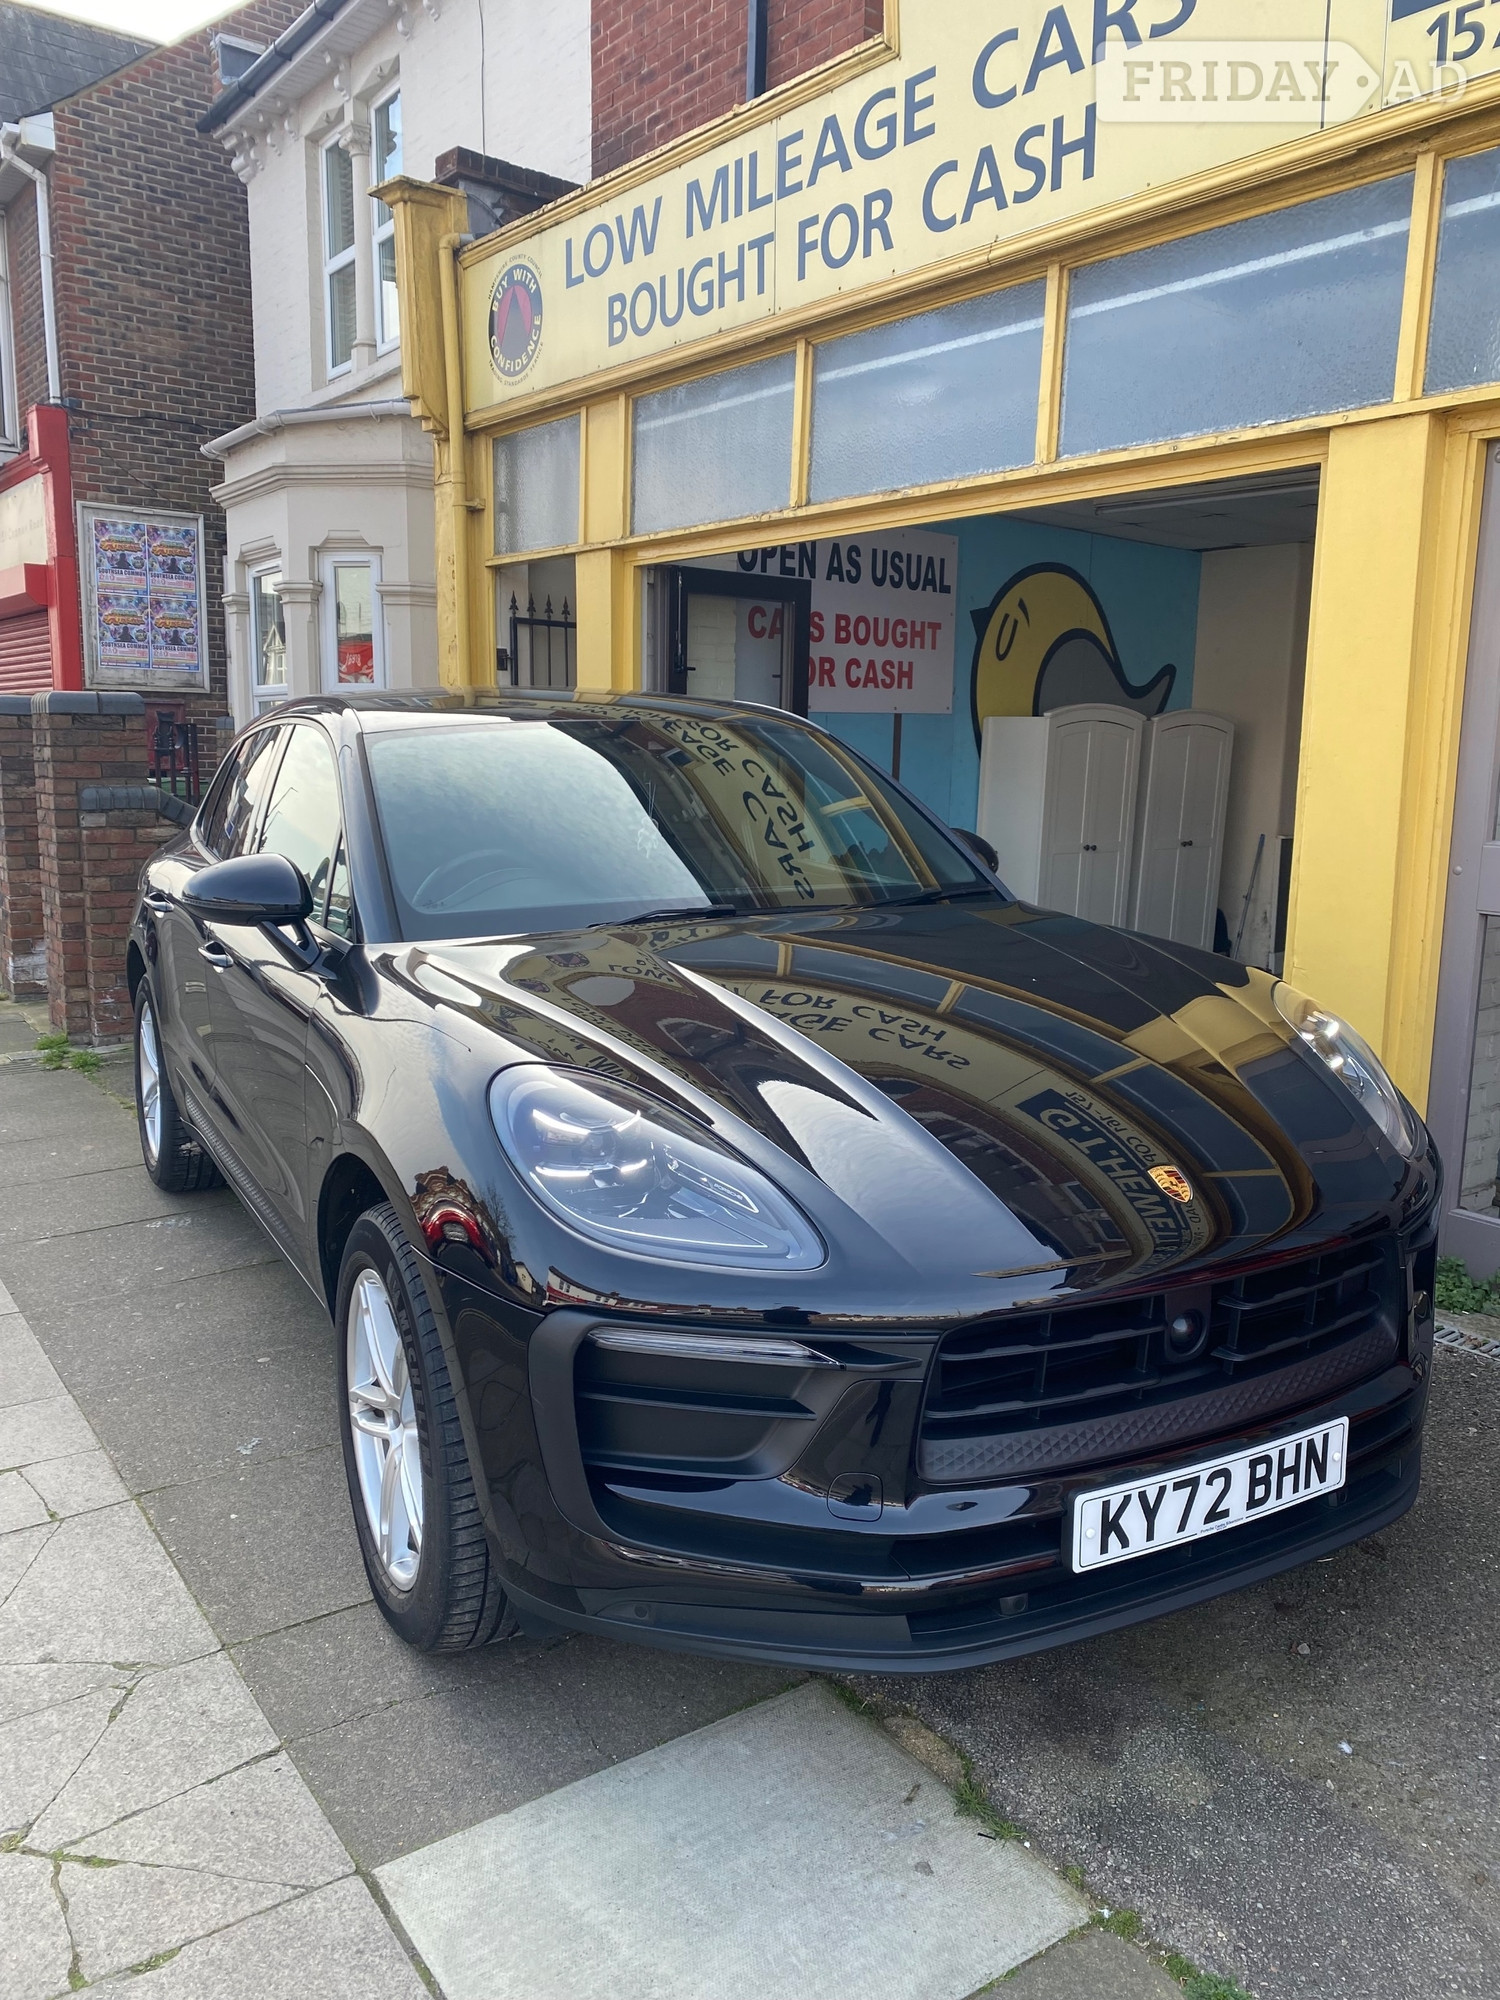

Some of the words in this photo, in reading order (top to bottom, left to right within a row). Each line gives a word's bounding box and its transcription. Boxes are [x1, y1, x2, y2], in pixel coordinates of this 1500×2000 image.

[1426, 0, 1500, 68] 15
[564, 196, 663, 289] LOW
[685, 66, 937, 239] MILEAGE
[607, 231, 775, 348] BOUGHT
[797, 188, 895, 281] FOR
[921, 101, 1097, 233] CASH
[491, 276, 509, 312] BUY
[513, 268, 537, 294] WITH
[490, 314, 542, 372] CONFIDENCE
[737, 541, 817, 579] OPEN
[825, 542, 862, 584] AS
[871, 548, 951, 594] USUAL
[747, 605, 825, 642] CAS
[835, 611, 942, 650] BOUGHT
[845, 658, 914, 689] CASH
[398, 1309, 433, 1469] MICHELIN
[1100, 1467, 1232, 1555] KY72
[1246, 1432, 1330, 1511] BHN
